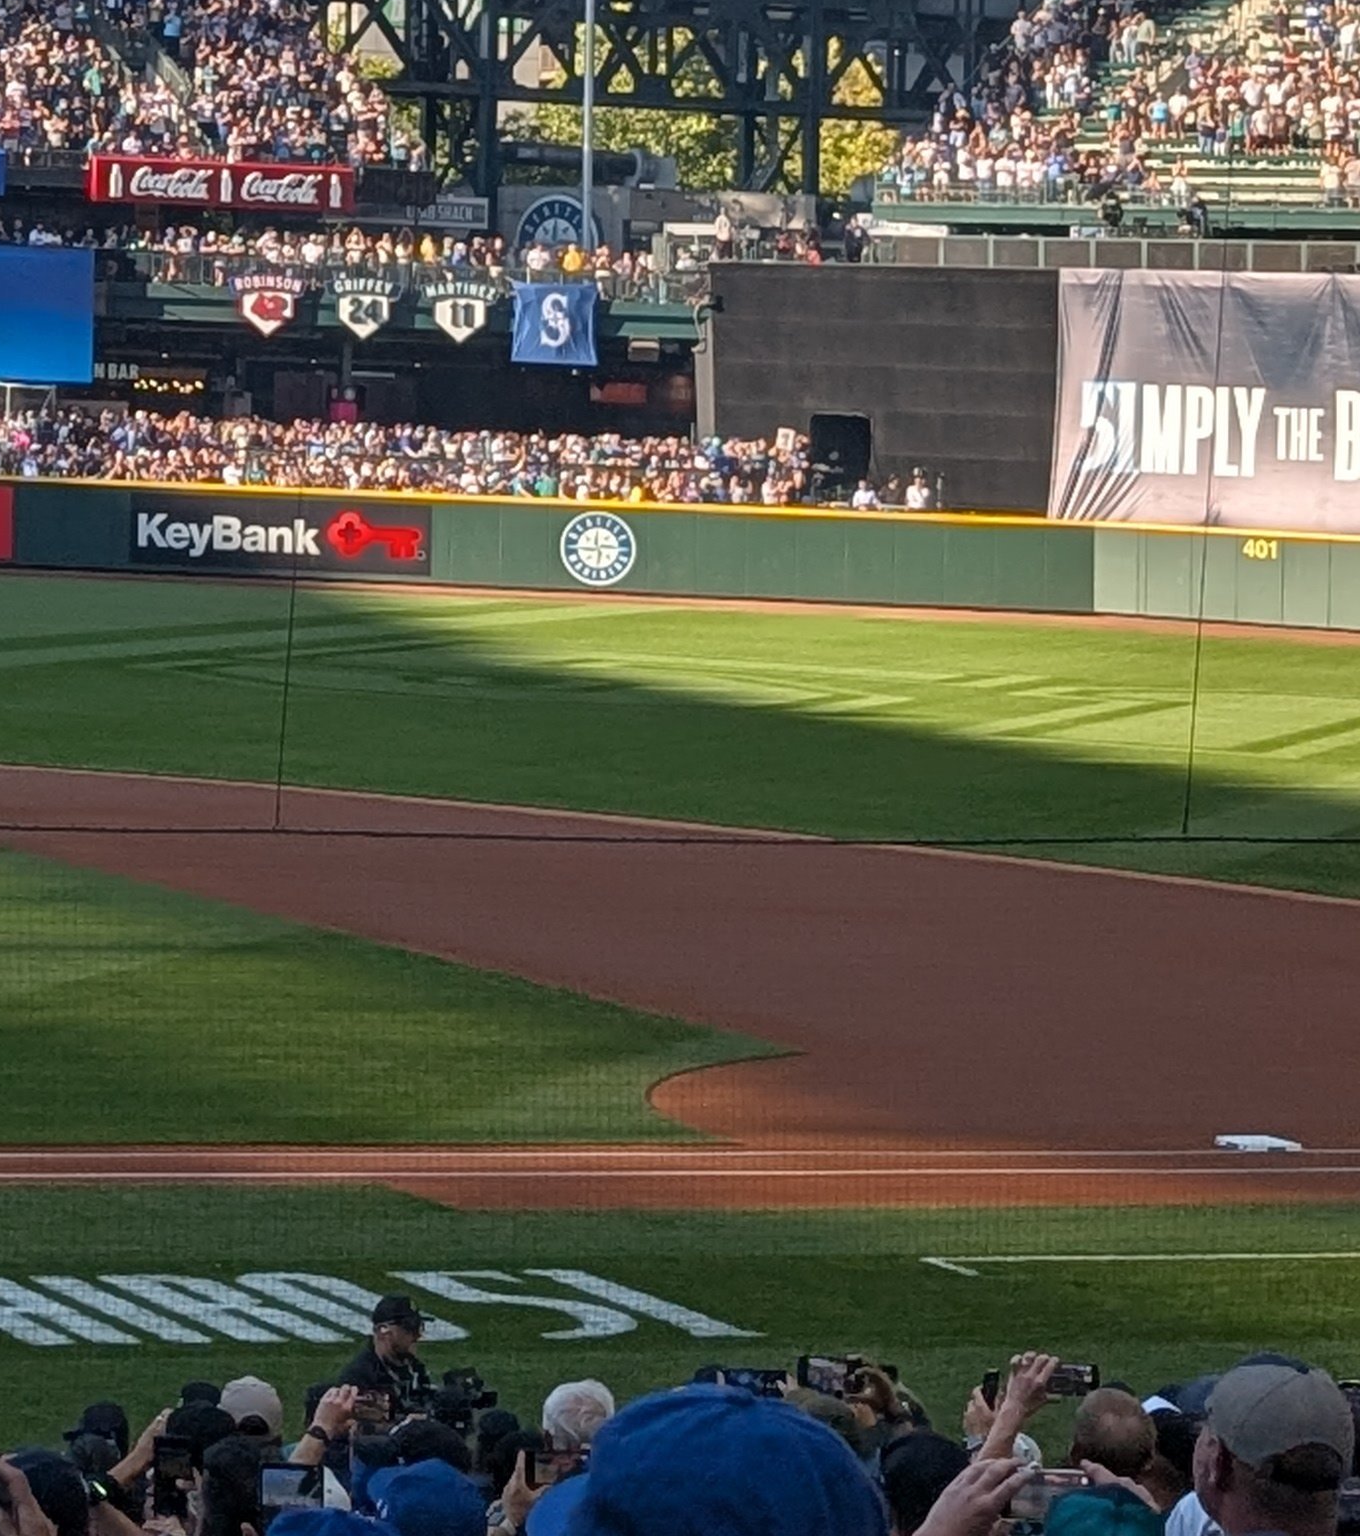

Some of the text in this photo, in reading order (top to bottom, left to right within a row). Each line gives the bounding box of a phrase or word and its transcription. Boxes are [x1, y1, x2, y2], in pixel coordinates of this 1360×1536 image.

[234, 275, 303, 293] ROBINSON
[334, 280, 392, 295] GRIFFEY
[426, 284, 498, 299] MARTINEZ
[349, 298, 381, 325] 24
[449, 302, 475, 328] 11
[540, 293, 570, 347] S
[108, 363, 139, 379] BAR
[1273, 407, 1325, 461] THE
[137, 512, 321, 557] KeyBank
[1242, 539, 1278, 559] 401
[386, 1268, 768, 1339] 51
